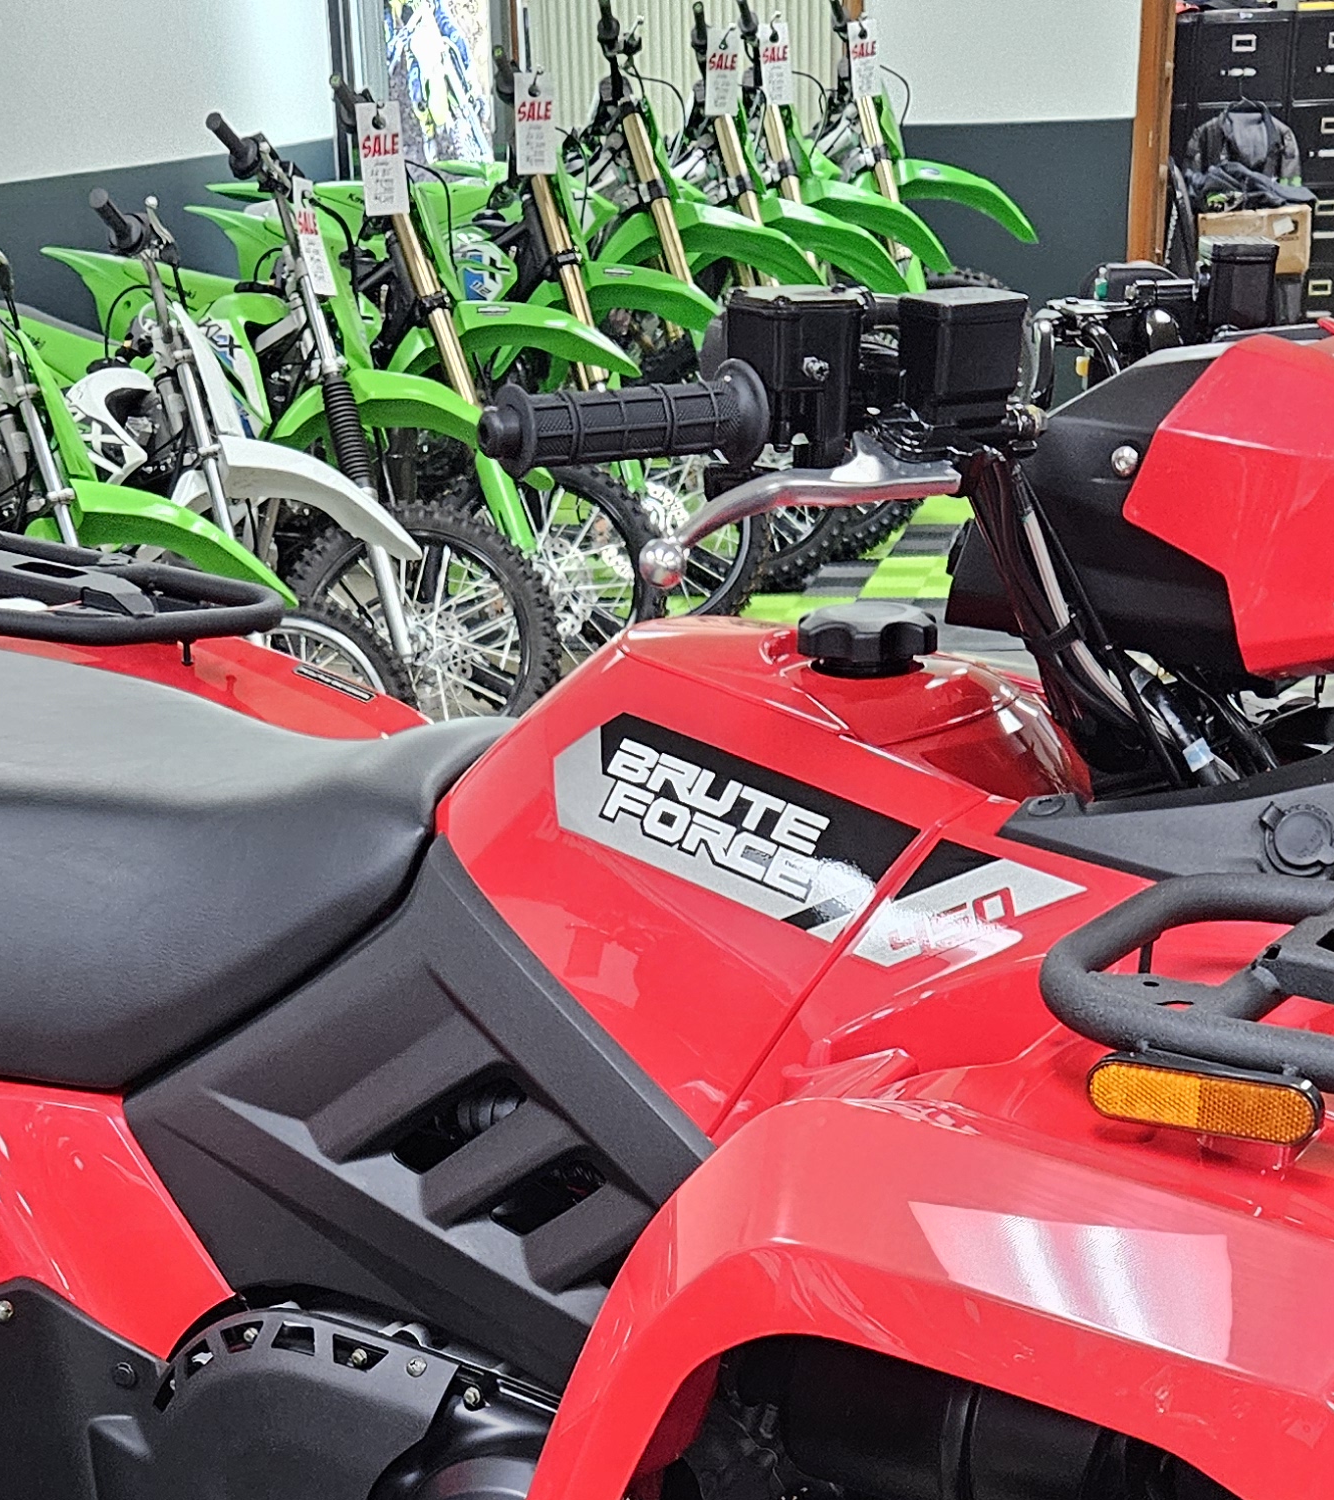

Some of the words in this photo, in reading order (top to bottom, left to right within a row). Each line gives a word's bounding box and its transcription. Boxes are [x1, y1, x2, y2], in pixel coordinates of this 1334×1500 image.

[762, 45, 788, 64] SALE
[850, 41, 877, 59] SALE
[708, 53, 738, 71] SALE
[517, 101, 552, 122] SALE
[361, 133, 399, 158] SALE
[605, 737, 831, 856] BRUTE
[599, 779, 814, 904] FORCE
